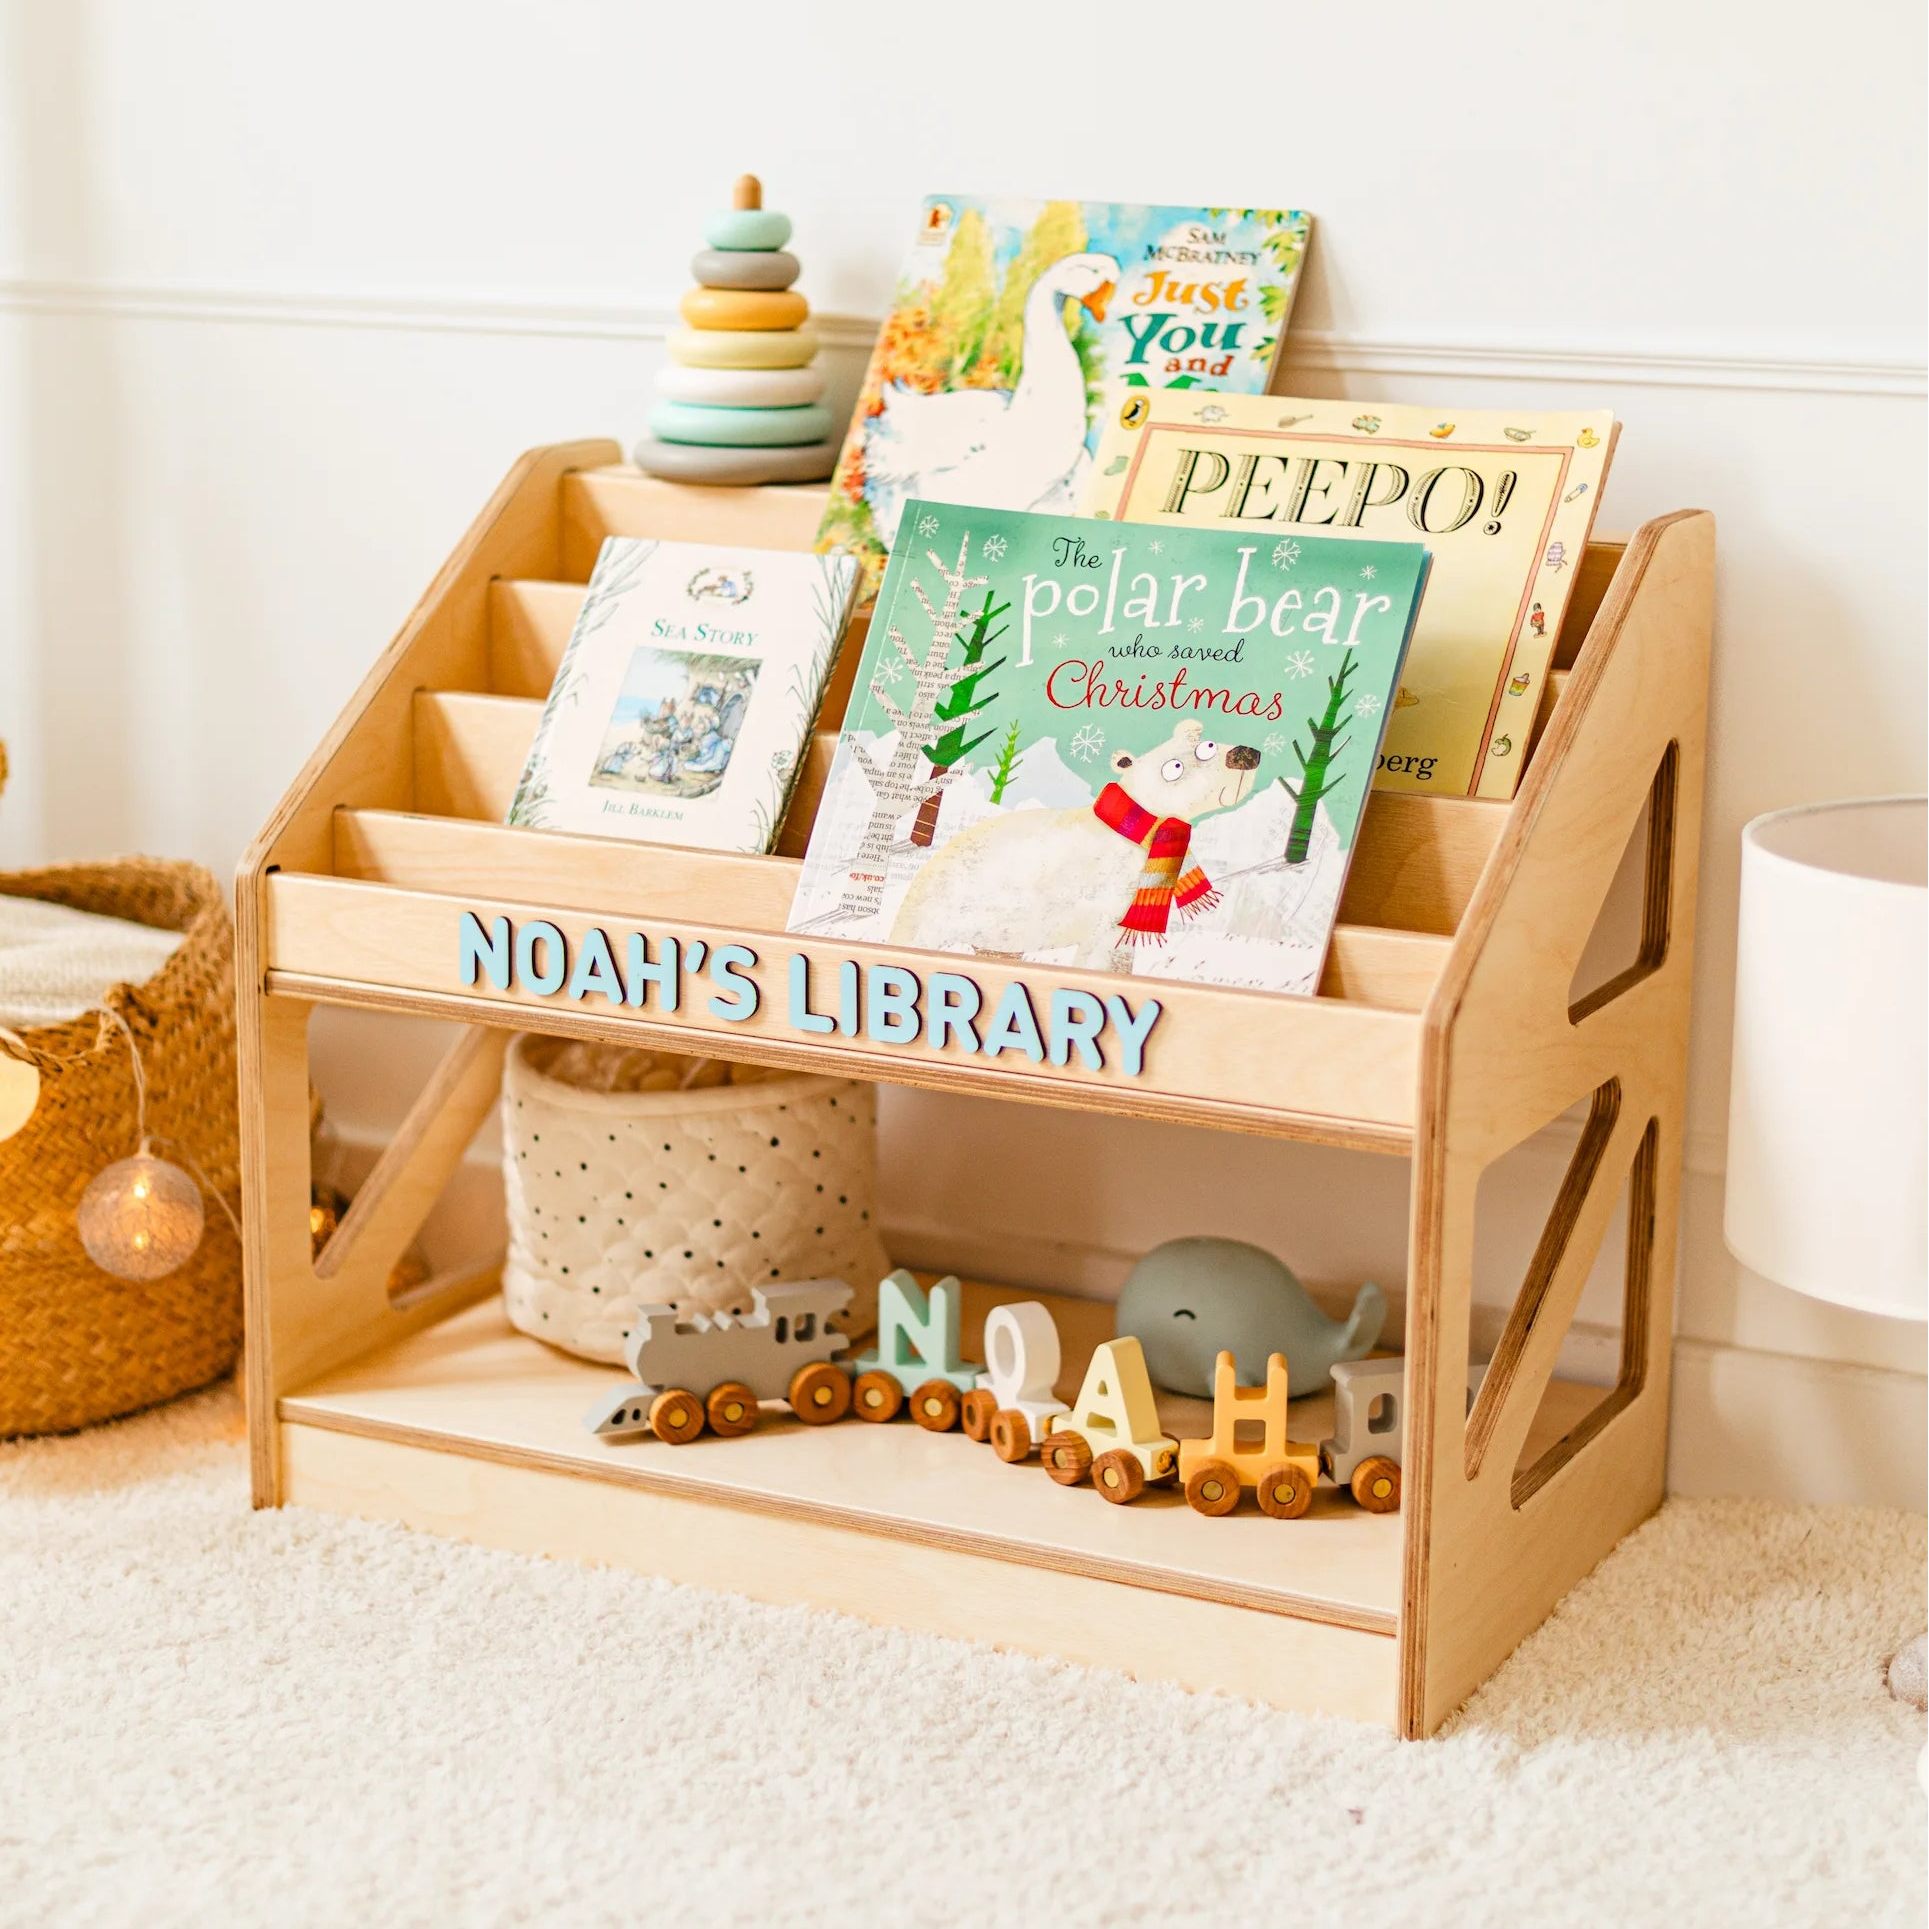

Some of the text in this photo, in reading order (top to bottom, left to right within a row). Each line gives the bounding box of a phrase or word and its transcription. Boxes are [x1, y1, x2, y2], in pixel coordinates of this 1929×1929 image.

[1132, 270, 1249, 314] Just
[1117, 313, 1248, 365] You
[1164, 354, 1235, 376] and
[1158, 448, 1518, 537] PEEPO!
[1052, 536, 1103, 571] The
[1016, 547, 1392, 668] polar bear
[650, 617, 760, 647] SEA STORY
[1108, 630, 1245, 664] who saved
[1045, 659, 1284, 721] Christmas
[459, 910, 1166, 1077] NOAH'S LIBRARY
